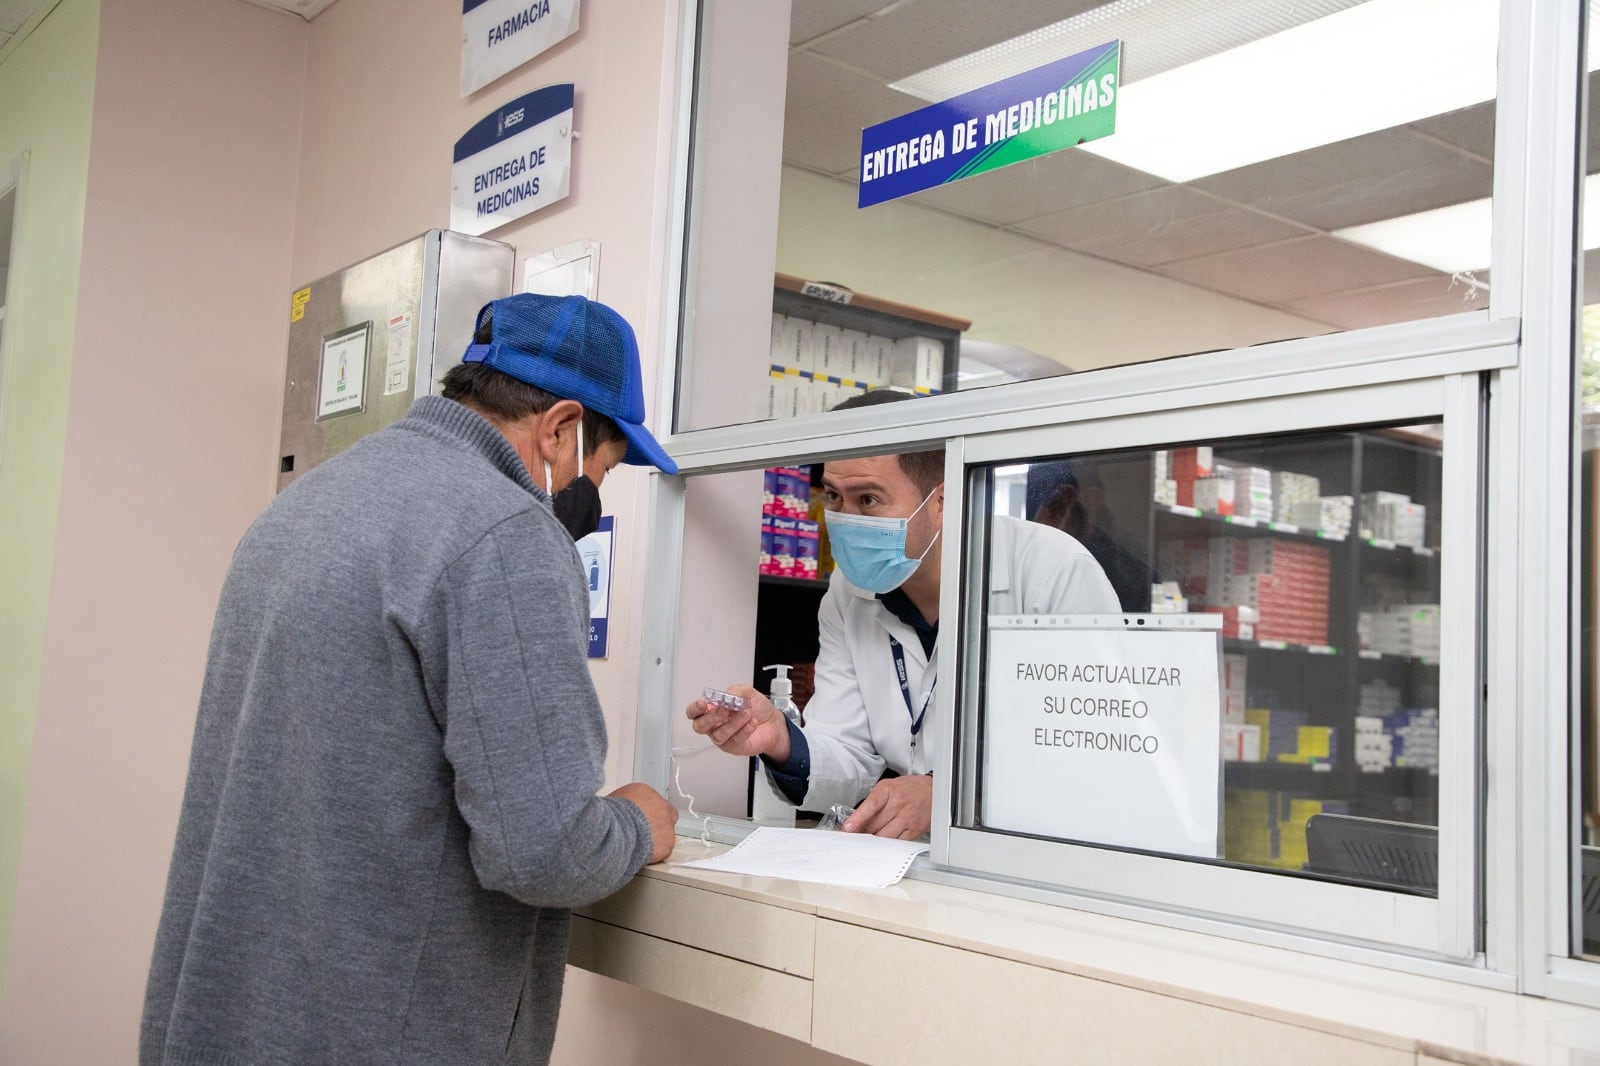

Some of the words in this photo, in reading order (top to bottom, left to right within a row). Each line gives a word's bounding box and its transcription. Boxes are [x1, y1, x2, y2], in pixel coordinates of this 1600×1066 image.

[488, 0, 550, 48] FARMACIA
[862, 129, 945, 183] ENTREGA
[951, 117, 978, 155] DE
[984, 73, 1115, 146] MEDICINAS
[474, 155, 526, 193] ENTREGA
[529, 146, 546, 169] DE
[476, 177, 540, 219] MEDICINAS
[1016, 663, 1068, 682] FAVOR
[1071, 665, 1182, 687] ACTUALIZAR
[1043, 696, 1066, 715] SU
[1070, 697, 1149, 719] CORREO
[1034, 728, 1159, 754] ELECTRONICO
